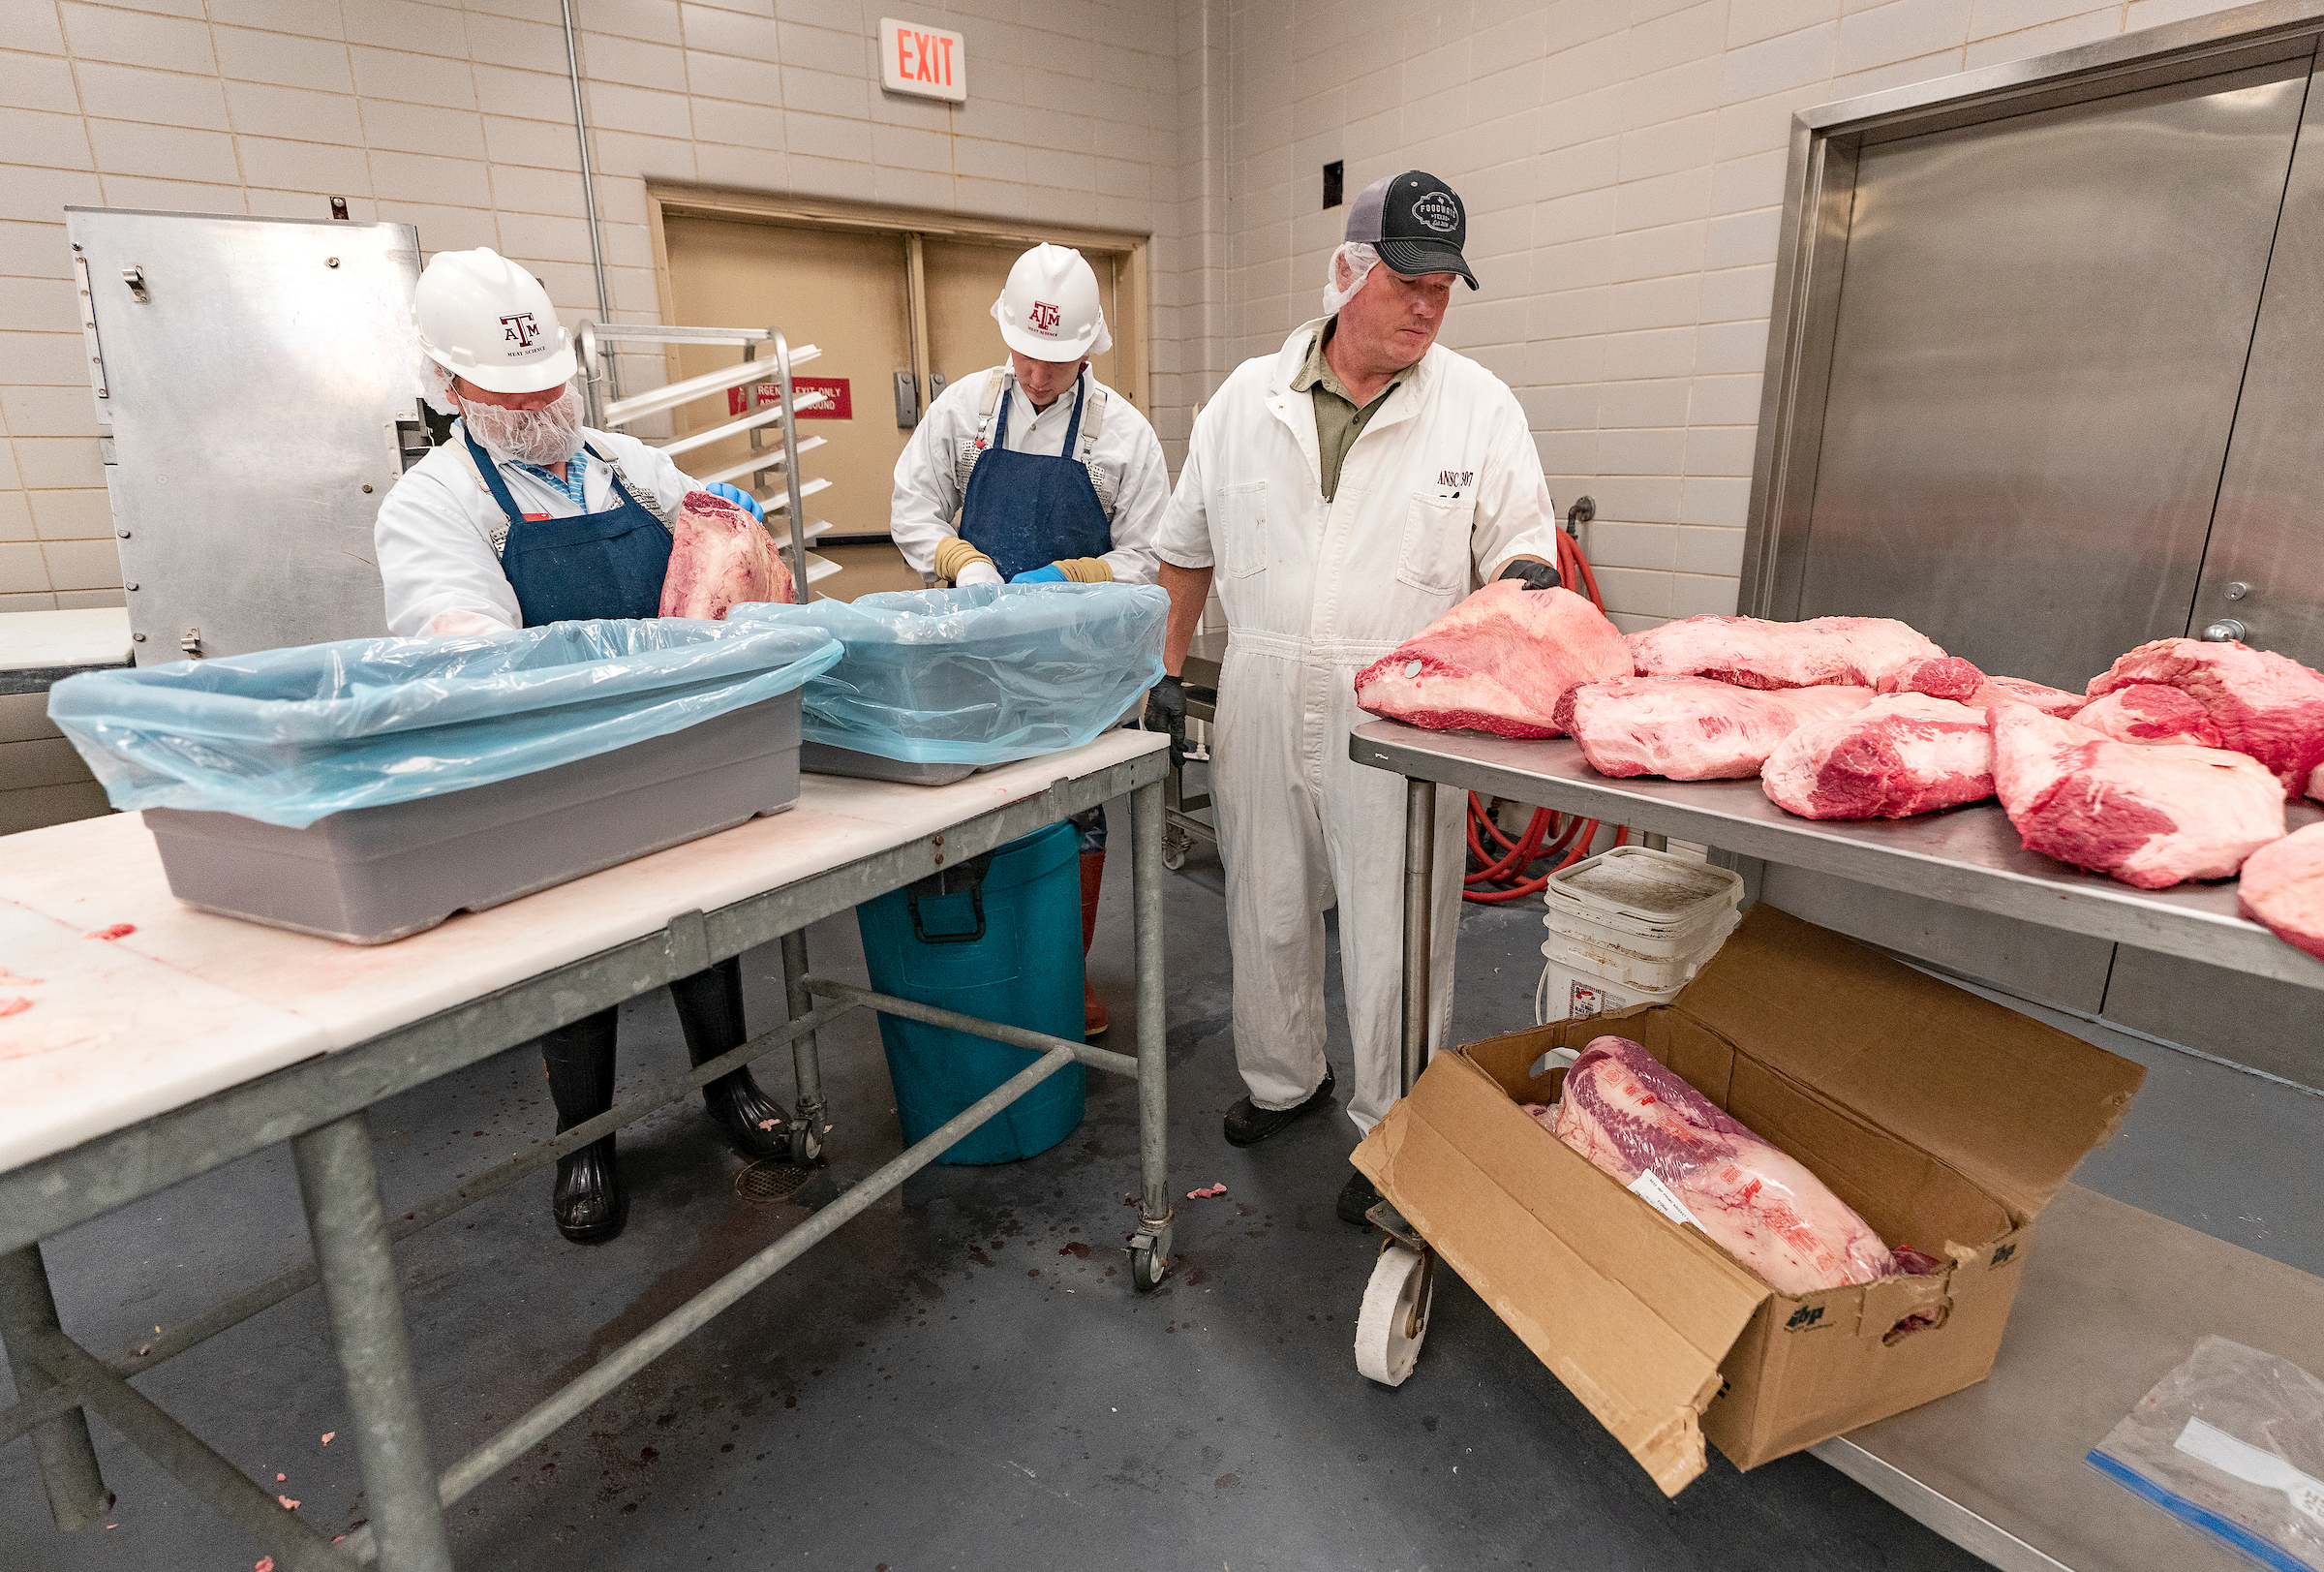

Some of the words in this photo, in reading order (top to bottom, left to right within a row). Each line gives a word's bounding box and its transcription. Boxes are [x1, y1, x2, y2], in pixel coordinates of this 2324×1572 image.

[897, 28, 954, 86] EXIT
[525, 346, 545, 354] SCIENCE
[818, 387, 841, 398] ONLY
[1436, 470, 1459, 488] ANSC
